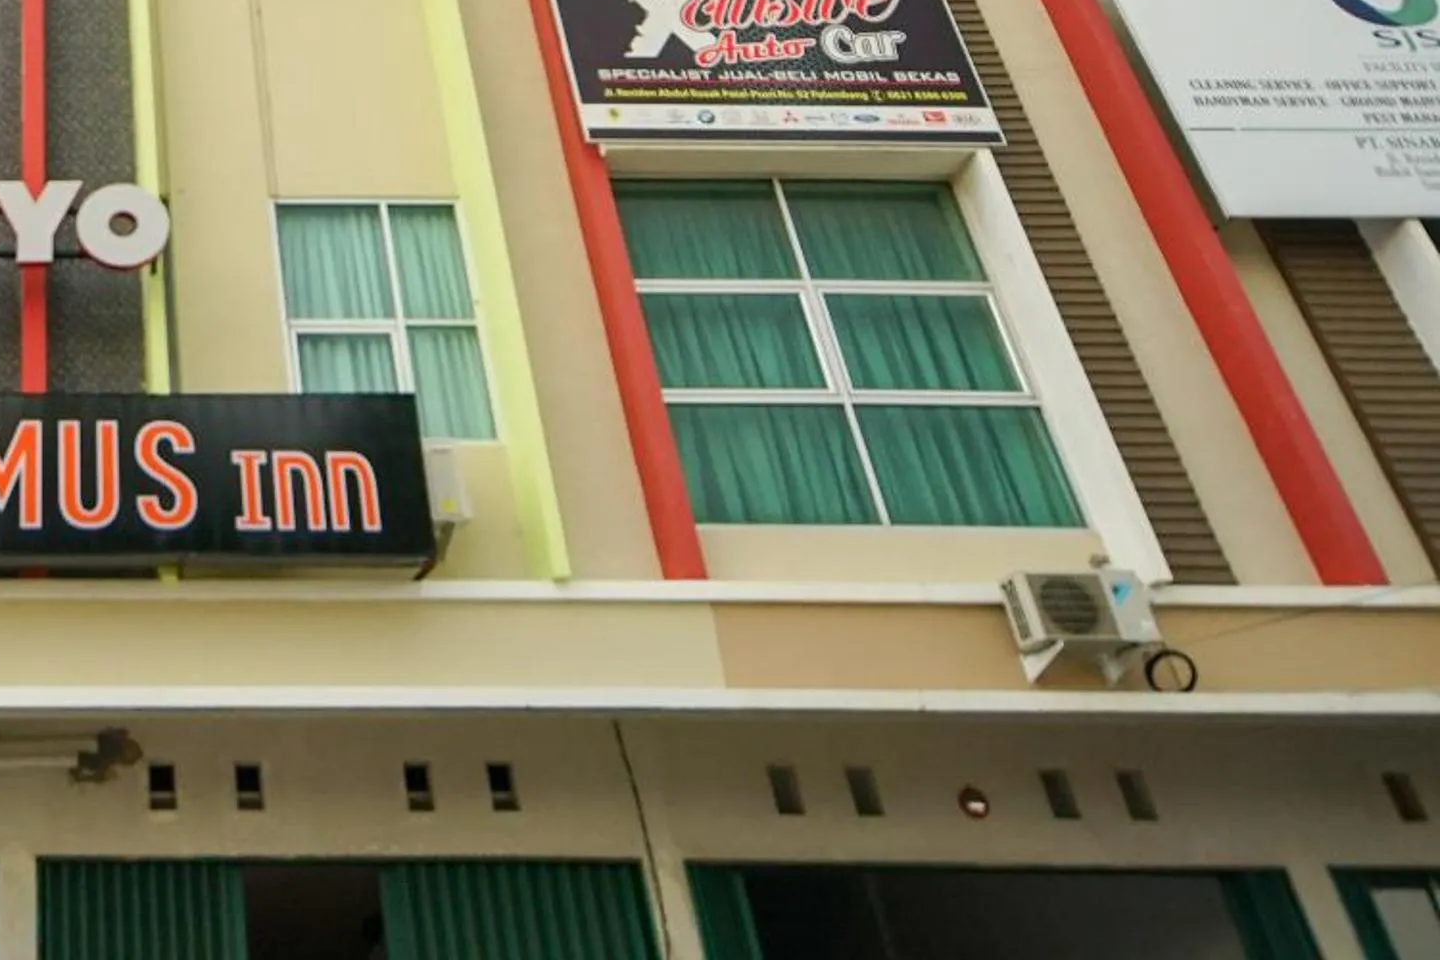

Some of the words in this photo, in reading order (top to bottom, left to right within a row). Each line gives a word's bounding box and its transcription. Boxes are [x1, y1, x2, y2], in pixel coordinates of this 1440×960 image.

[695, 30, 816, 69] Auto
[820, 23, 907, 64] Car
[596, 68, 712, 81] SPECIALIST
[824, 70, 888, 82] MOBIL
[893, 70, 961, 83] BEKAS
[1188, 78, 1257, 91] CLEANING
[1258, 79, 1316, 91] SERVICE
[1324, 79, 1372, 91] OFFICE
[1374, 79, 1437, 91] SUPPORT
[1272, 95, 1328, 108] SERVICE
